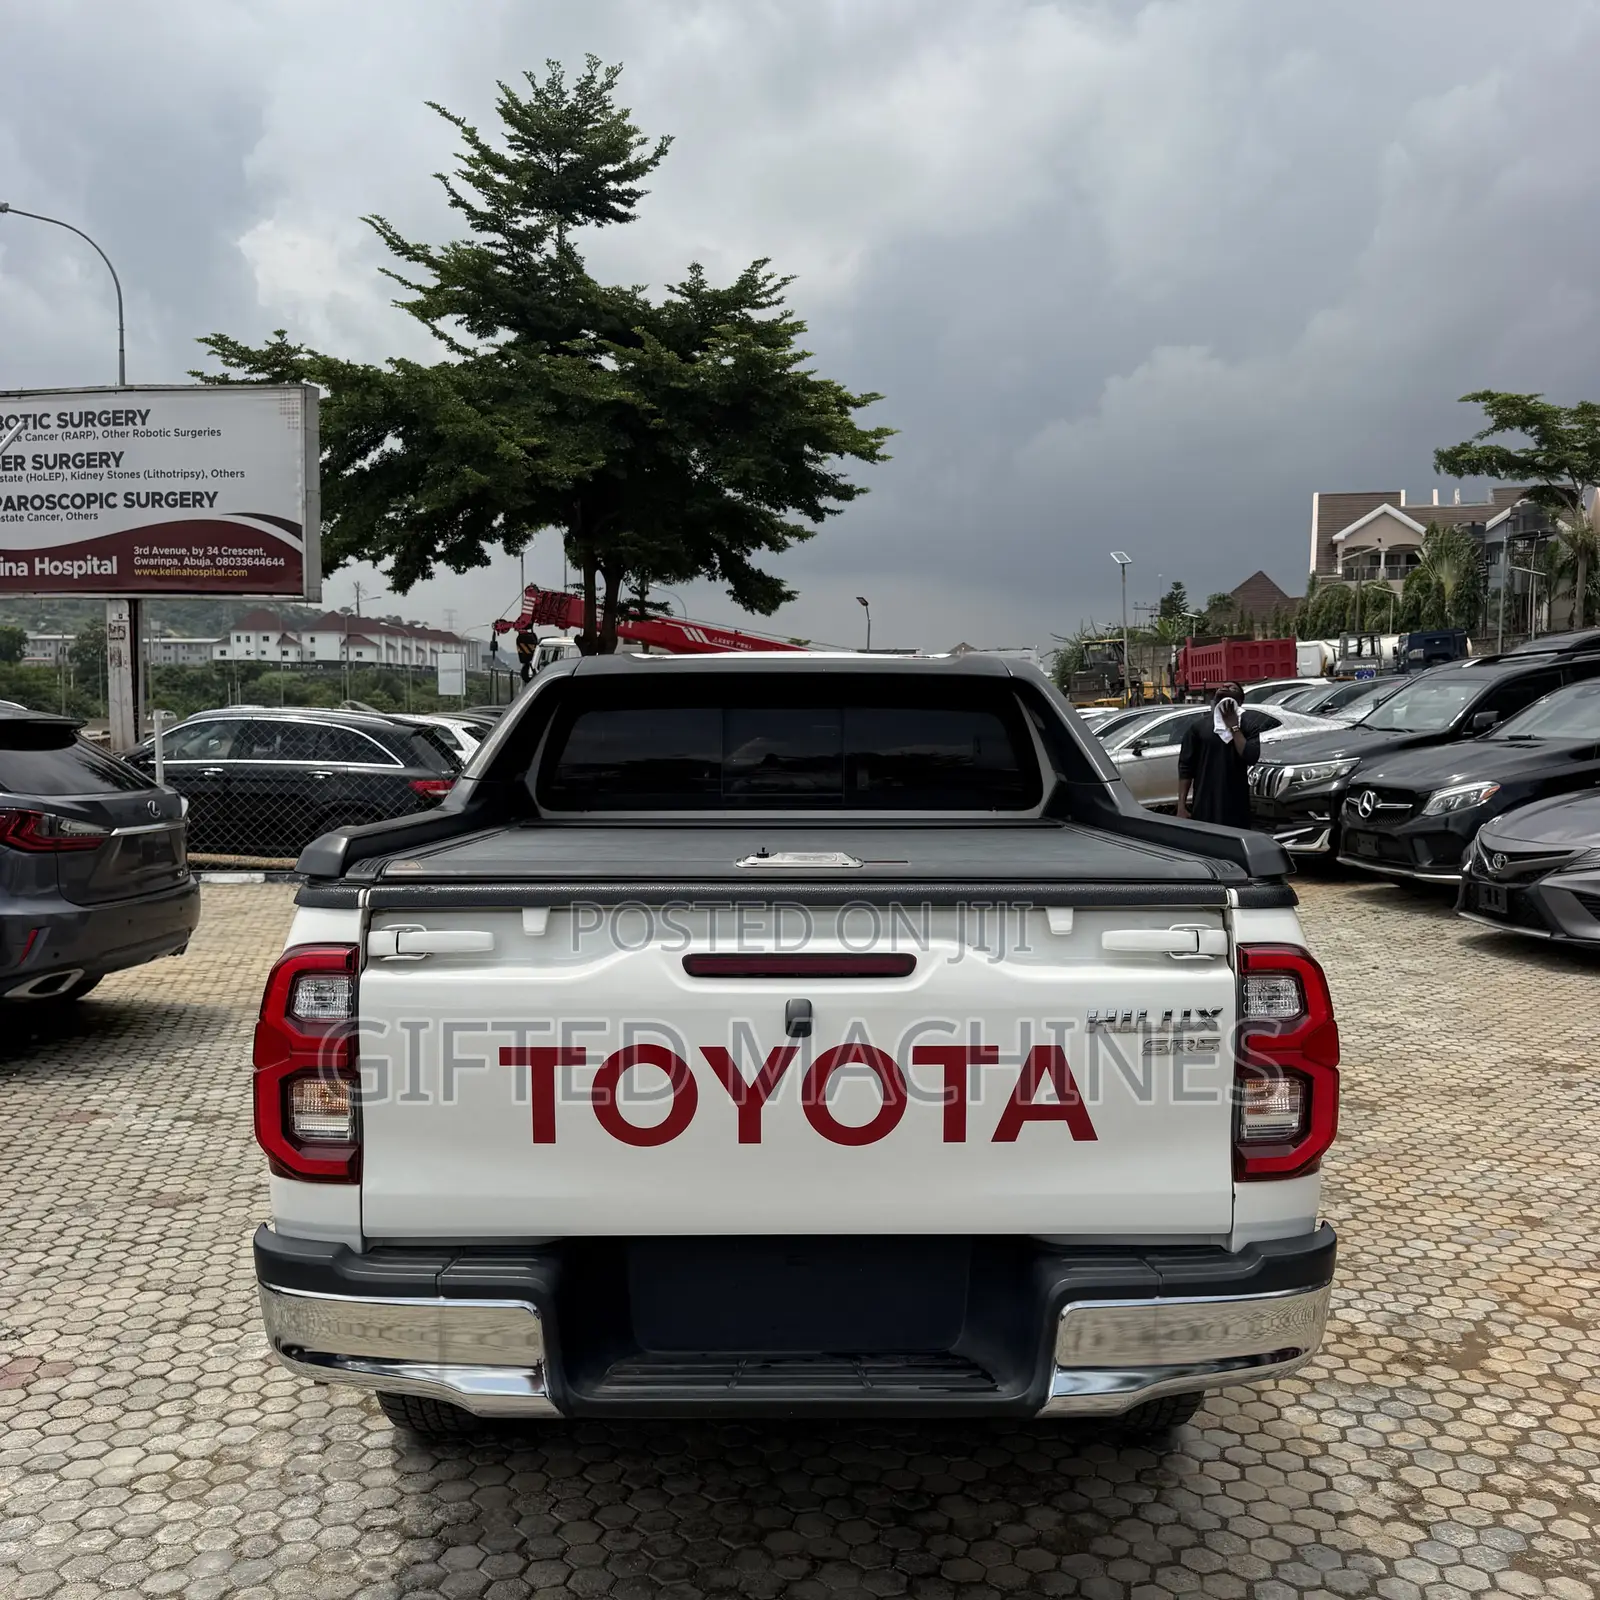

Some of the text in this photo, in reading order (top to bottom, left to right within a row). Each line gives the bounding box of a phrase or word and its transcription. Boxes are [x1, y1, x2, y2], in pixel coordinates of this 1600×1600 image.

[56, 409, 151, 429] SURGERY
[25, 432, 59, 442] Cancer
[61, 430, 99, 442] (RARP),
[102, 430, 130, 439] Other
[133, 428, 171, 438] Robotic
[174, 428, 222, 440] Surgeries
[0, 451, 125, 472] ER SURGERY
[26, 471, 68, 483] (HoLEP),
[70, 470, 104, 482] Kidney
[107, 469, 141, 480] Stones
[143, 468, 208, 481] (Lithotripsy),
[211, 468, 245, 479] Others
[0, 490, 219, 512] AROSCOPIC SURGERY
[27, 512, 63, 523] Cancer,
[66, 511, 98, 521] Others
[133, 545, 267, 557] 3rd Avenue, by 34 Crescent,
[34, 555, 118, 579] Hospital
[134, 557, 285, 567] Gwarinpa, Abuja. 08033644644
[134, 567, 248, 578] www.kelinahospital.com
[1085, 1006, 1224, 1033] HILUX
[1142, 1036, 1221, 1056] SR5
[500, 1043, 1098, 1147] TOYOTA
